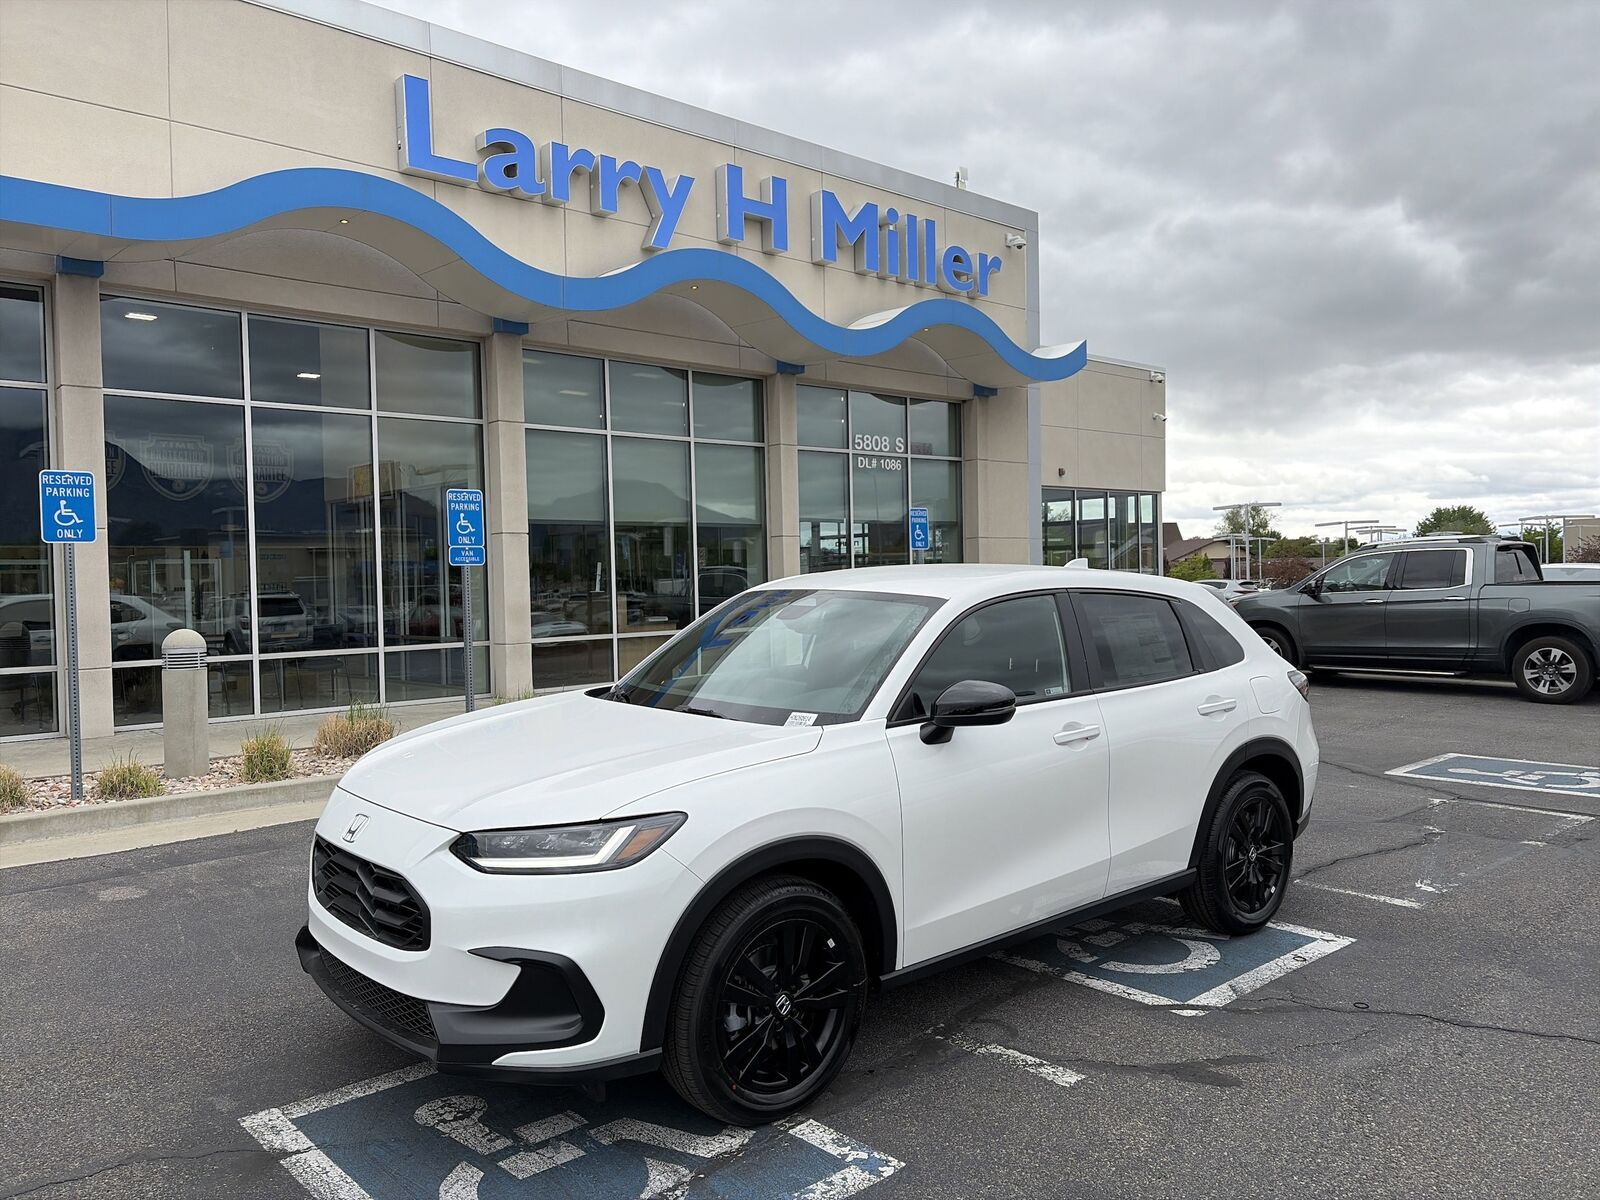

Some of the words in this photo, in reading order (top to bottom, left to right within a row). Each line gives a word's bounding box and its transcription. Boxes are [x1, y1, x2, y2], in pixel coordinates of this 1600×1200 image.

[396, 73, 696, 250] Larry
[718, 163, 789, 252] H
[813, 189, 1003, 297] Miller
[854, 434, 890, 452] 5808
[895, 437, 905, 453] S
[858, 456, 877, 469] DL#
[880, 458, 902, 471] 1086
[42, 474, 92, 486] RESERVED
[45, 487, 90, 498] PARKING
[448, 492, 481, 502] RESERVED
[450, 502, 480, 511] PARKING
[56, 528, 83, 539] ONLY
[458, 536, 476, 544] ONLY
